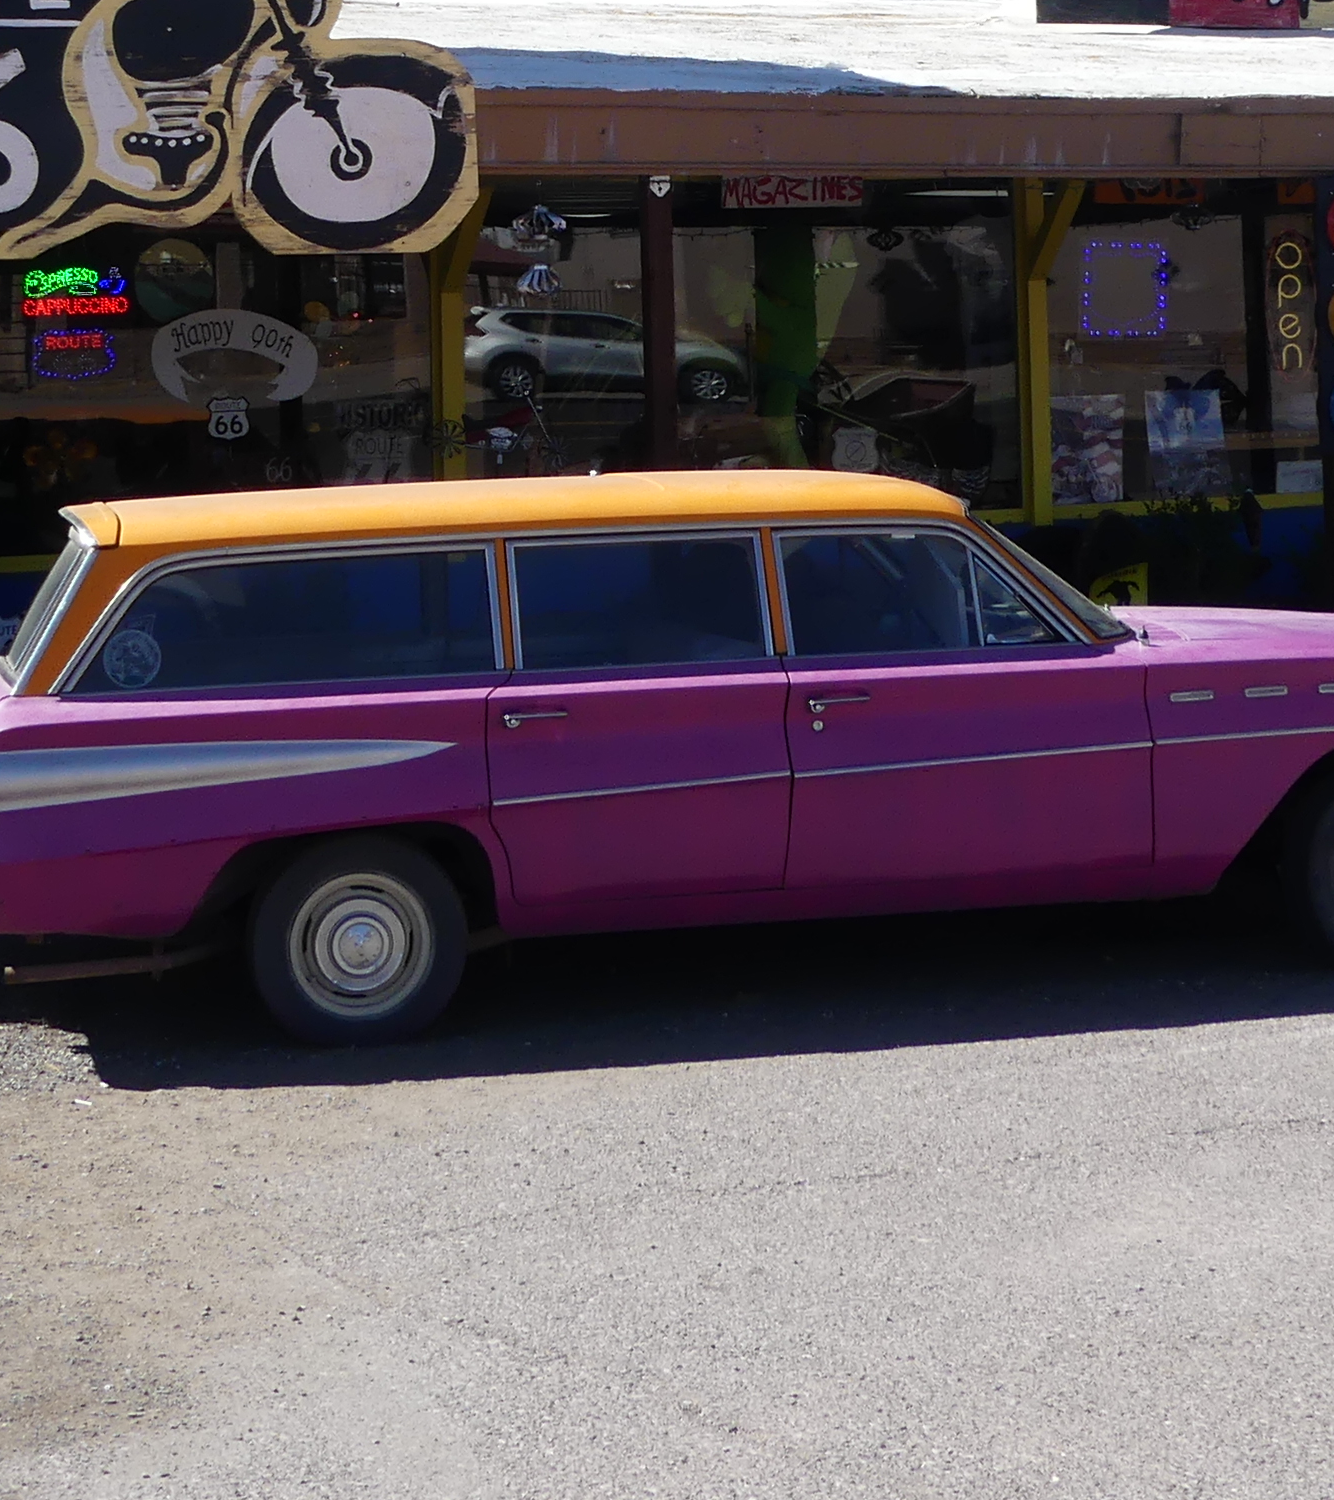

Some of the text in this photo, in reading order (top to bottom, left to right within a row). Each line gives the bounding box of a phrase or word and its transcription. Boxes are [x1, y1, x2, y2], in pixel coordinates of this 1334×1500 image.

[722, 175, 864, 208] MAGAZINES
[22, 296, 129, 316] CAPPUCCINO
[45, 333, 103, 351] ROUTE
[171, 318, 235, 353] Happy
[215, 415, 244, 435] 66
